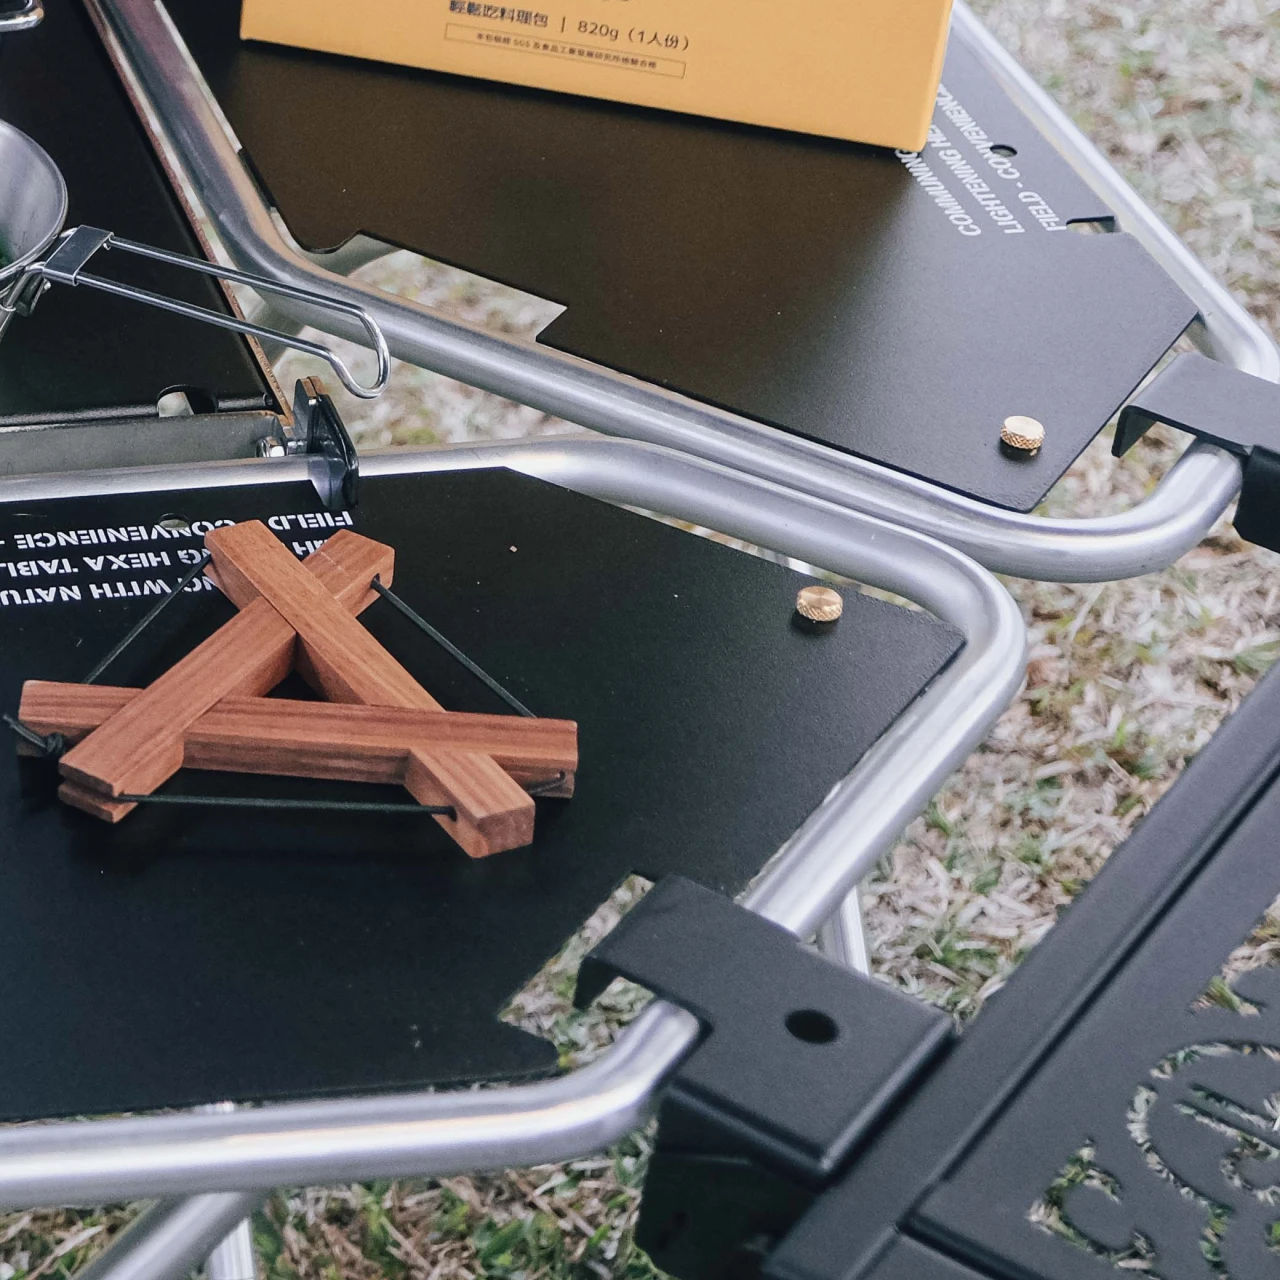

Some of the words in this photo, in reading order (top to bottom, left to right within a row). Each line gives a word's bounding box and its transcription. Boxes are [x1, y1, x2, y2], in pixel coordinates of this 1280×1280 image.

[577, 20, 620, 42] 820g
[939, 149, 1025, 234] LIGHTENING
[1018, 191, 1067, 232] FIELD
[267, 510, 354, 531] FIELD
[83, 551, 172, 572] HEXA
[89, 578, 172, 600] WITH
